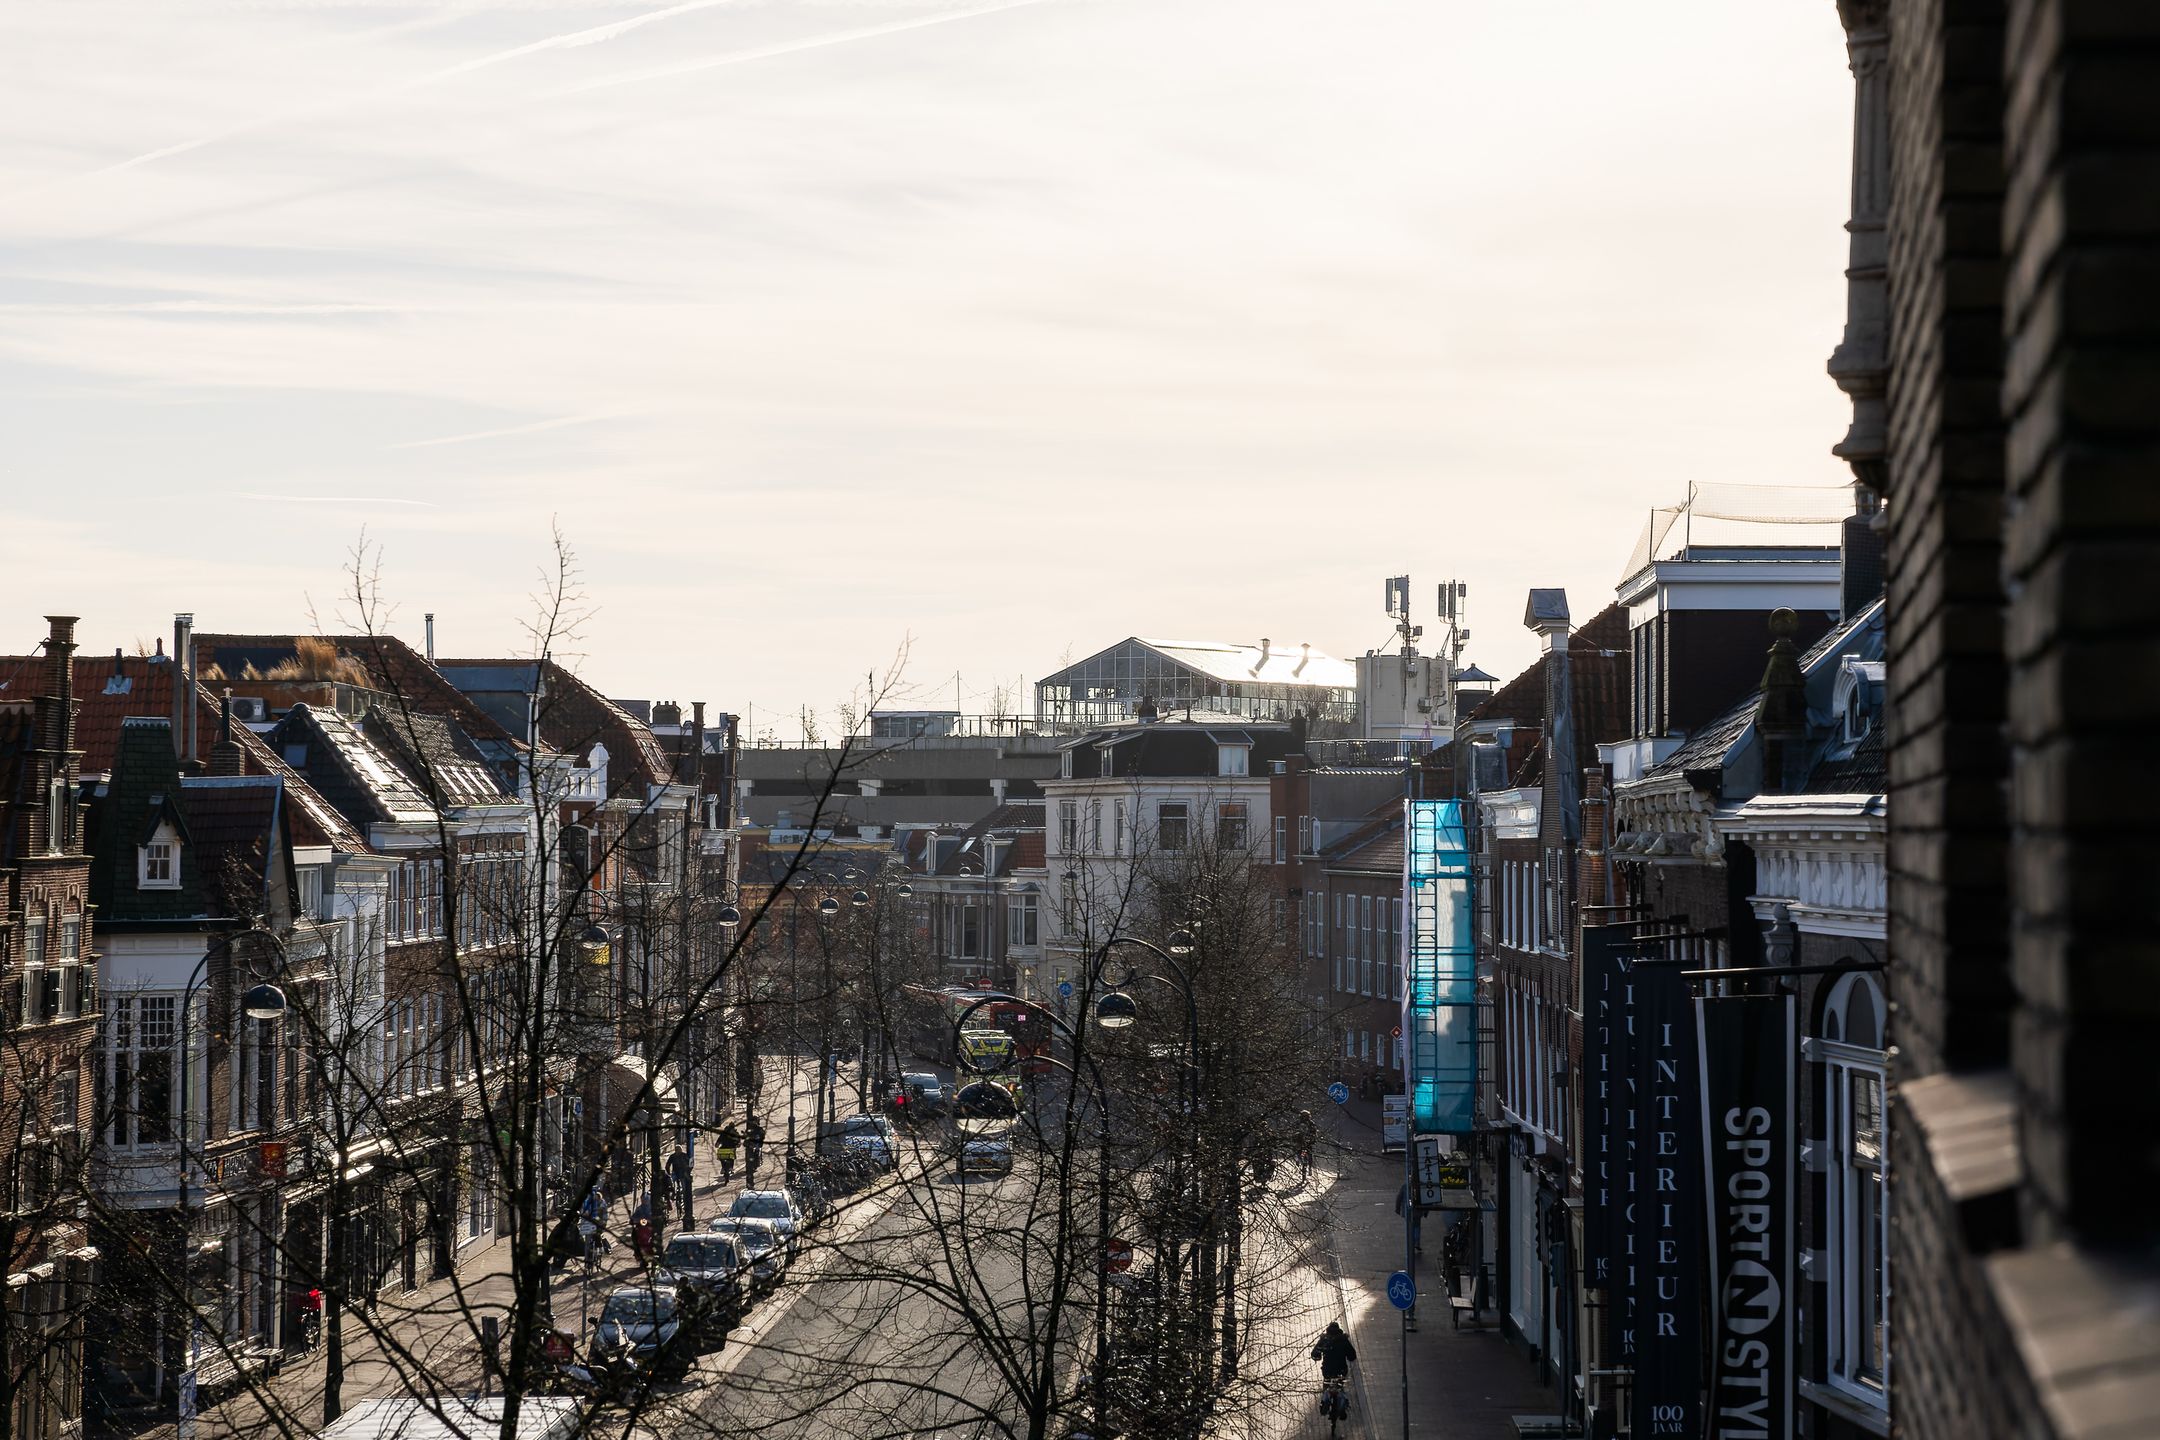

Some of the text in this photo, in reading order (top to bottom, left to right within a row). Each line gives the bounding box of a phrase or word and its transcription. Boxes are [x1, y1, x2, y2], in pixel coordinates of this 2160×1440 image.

[1423, 1146, 1435, 1199] TATTOO
[1656, 1023, 1679, 1337] INTERIEUR
[1650, 1422, 1684, 1435] JAAR
[1651, 1405, 1684, 1422] 100
